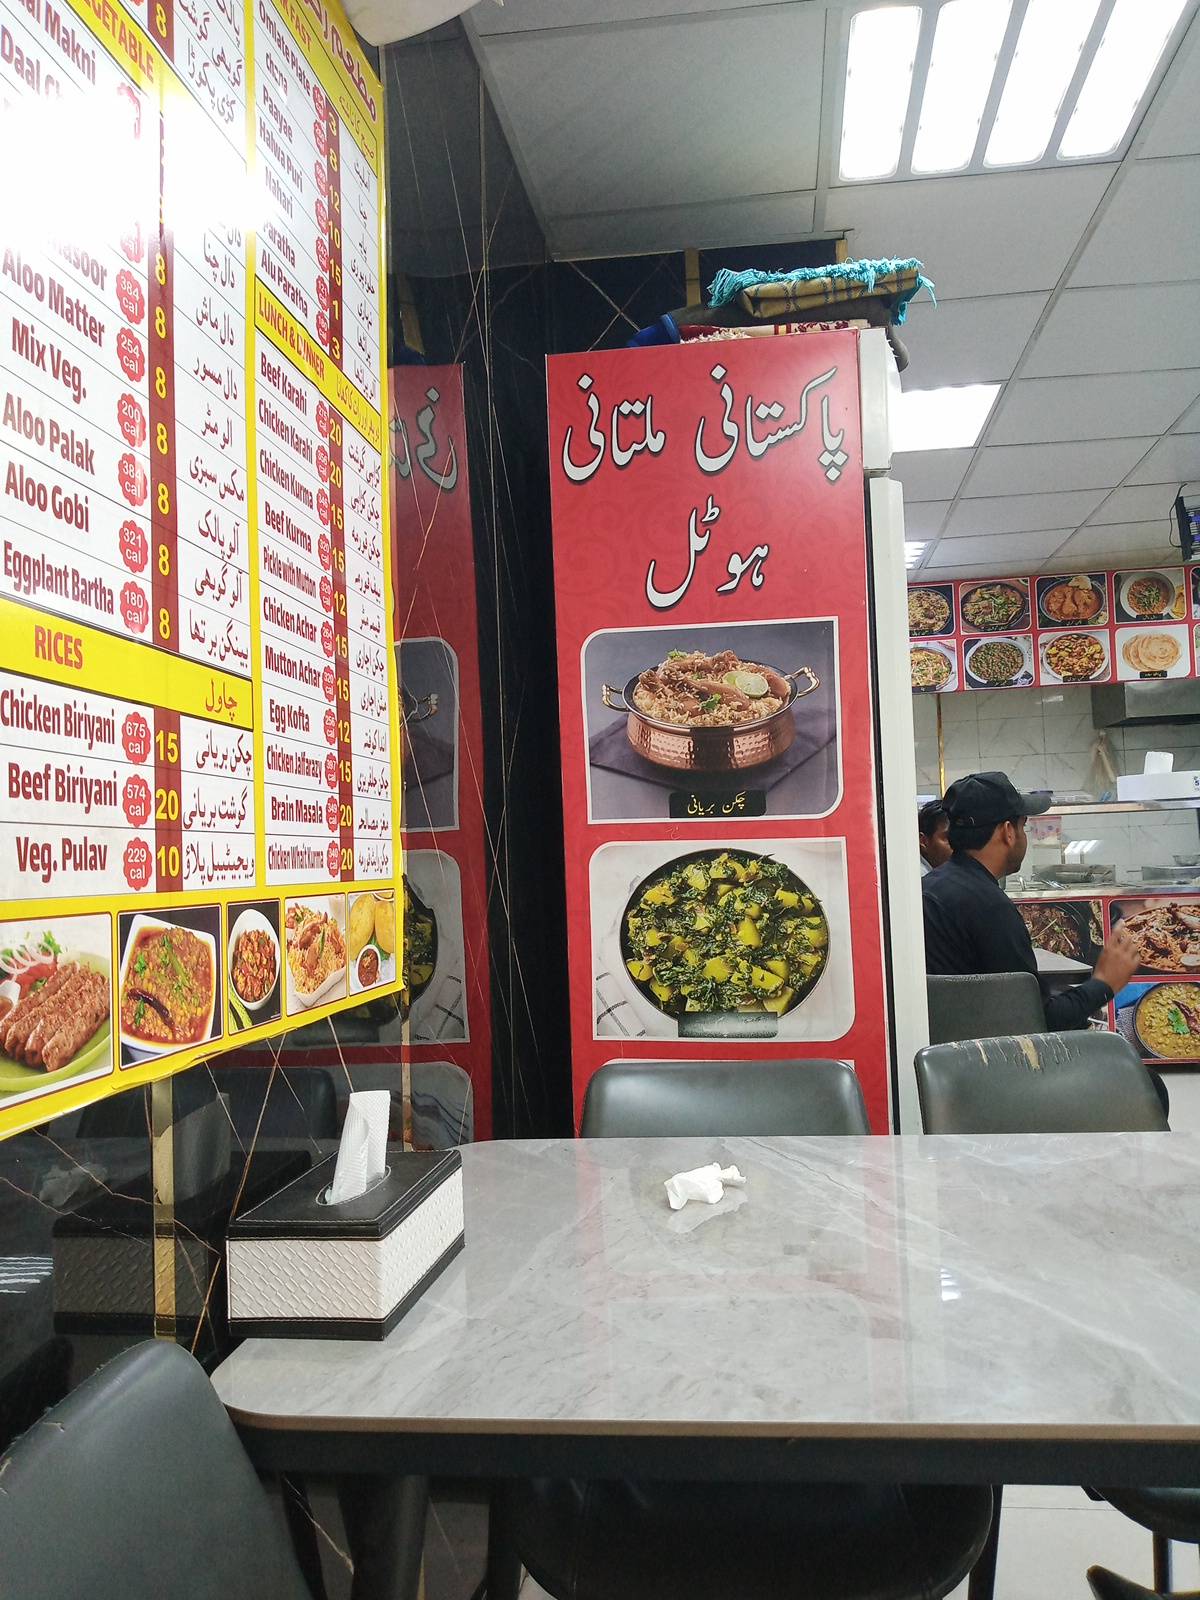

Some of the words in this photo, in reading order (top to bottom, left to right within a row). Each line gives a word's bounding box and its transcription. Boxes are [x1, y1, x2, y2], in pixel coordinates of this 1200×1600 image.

[155, 2, 167, 38] 8
[45, 1, 96, 86] Makni
[259, 0, 290, 63] Omlate
[291, 50, 310, 96] Plate
[1, 24, 41, 96] Daal
[329, 112, 336, 136] 3
[287, 155, 302, 193] Puri
[330, 148, 337, 172] 8
[329, 186, 340, 213] 12
[328, 220, 340, 248] 10
[155, 251, 166, 285] 8
[221, 255, 235, 288] دال
[330, 258, 341, 286] 15
[2, 249, 45, 303] Aloo
[48, 276, 105, 348] Matter
[120, 276, 139, 299] 384
[261, 250, 276, 282] Alu
[278, 266, 307, 318] Paratha
[123, 298, 138, 316] cal
[156, 307, 166, 338] 8
[333, 300, 338, 320] 1
[220, 312, 234, 346] دال
[260, 295, 288, 342] LUNCH
[289, 327, 295, 350] &
[297, 335, 324, 381] DINNER
[12, 317, 47, 373] Mix
[49, 343, 87, 405] Veg.
[120, 334, 139, 358] 254
[332, 337, 340, 359] 3
[123, 357, 138, 374] cal
[194, 358, 222, 385] مسور
[156, 367, 166, 398] 8
[224, 368, 237, 400] دال
[261, 352, 280, 390] Beef
[282, 372, 306, 416] Karahi
[122, 400, 140, 424] 200
[562, 373, 666, 482] ملتانی
[695, 363, 849, 482] پاکستانی
[2, 392, 46, 447] Aloo
[48, 418, 96, 476] Palak
[124, 419, 139, 438] cal
[157, 423, 168, 454] 8
[259, 398, 289, 444] Chicken
[291, 426, 312, 464] Karahi
[330, 418, 341, 446] 20
[122, 460, 140, 480] 384
[190, 457, 216, 487] سبزی
[260, 449, 289, 492] Chicken
[290, 473, 313, 510] Kurma
[330, 462, 341, 488] 20
[5, 460, 48, 513] Aloo
[51, 483, 90, 534] Gobi
[125, 480, 140, 499] cal
[158, 483, 169, 514] 8
[265, 502, 284, 535] Beef
[286, 516, 312, 553] Kurma
[331, 504, 342, 529] 15
[122, 528, 141, 546] 321
[197, 510, 225, 560] پالک
[226, 522, 240, 559] آلو
[126, 550, 141, 564] cal
[159, 544, 169, 575] 8
[264, 545, 282, 579] Pickle
[282, 558, 295, 586] with
[333, 548, 344, 573] 15
[646, 495, 770, 609] ہوٹل
[4, 539, 70, 597] Eggplant
[71, 567, 115, 616] Bartha
[228, 562, 242, 608] آلو
[124, 590, 143, 607] 180
[334, 591, 346, 616] 12
[126, 608, 142, 624] cal
[160, 608, 170, 639] 8
[264, 597, 295, 632] Chicken
[296, 613, 317, 642] Achar
[34, 624, 83, 670] RICES
[336, 634, 347, 658] 15
[266, 645, 297, 680] Mutton
[299, 660, 320, 688] Achar
[206, 680, 237, 721] چاول
[337, 678, 348, 701] 15
[1, 687, 61, 736] Chicken
[63, 699, 116, 750] Biriyani
[125, 722, 146, 738] 675
[270, 699, 286, 733] Egg
[288, 704, 309, 732] Kofta
[338, 720, 350, 743] 12
[129, 741, 144, 754] cal
[156, 730, 178, 762] 15
[196, 730, 228, 769] بریانی
[230, 734, 252, 776] چکن
[267, 744, 294, 773] Chicken
[340, 760, 351, 782] 15
[8, 762, 51, 801] Beef
[54, 765, 117, 814] Biriyani
[126, 784, 146, 800] 574
[721, 791, 746, 814] چکن
[129, 802, 144, 816] cal
[156, 788, 178, 821] 20
[181, 784, 217, 831] بریانی
[218, 786, 247, 829] گوشت
[272, 795, 294, 821] Brain
[296, 800, 322, 823] Masala
[340, 804, 352, 827] 20
[687, 794, 716, 817] بریانی
[16, 836, 58, 884] Veg.
[61, 836, 108, 872] Pulav
[126, 847, 146, 862] 229
[156, 846, 179, 878] 10
[268, 842, 290, 870] Chicken
[341, 848, 352, 871] 20
[130, 865, 145, 879] cal
